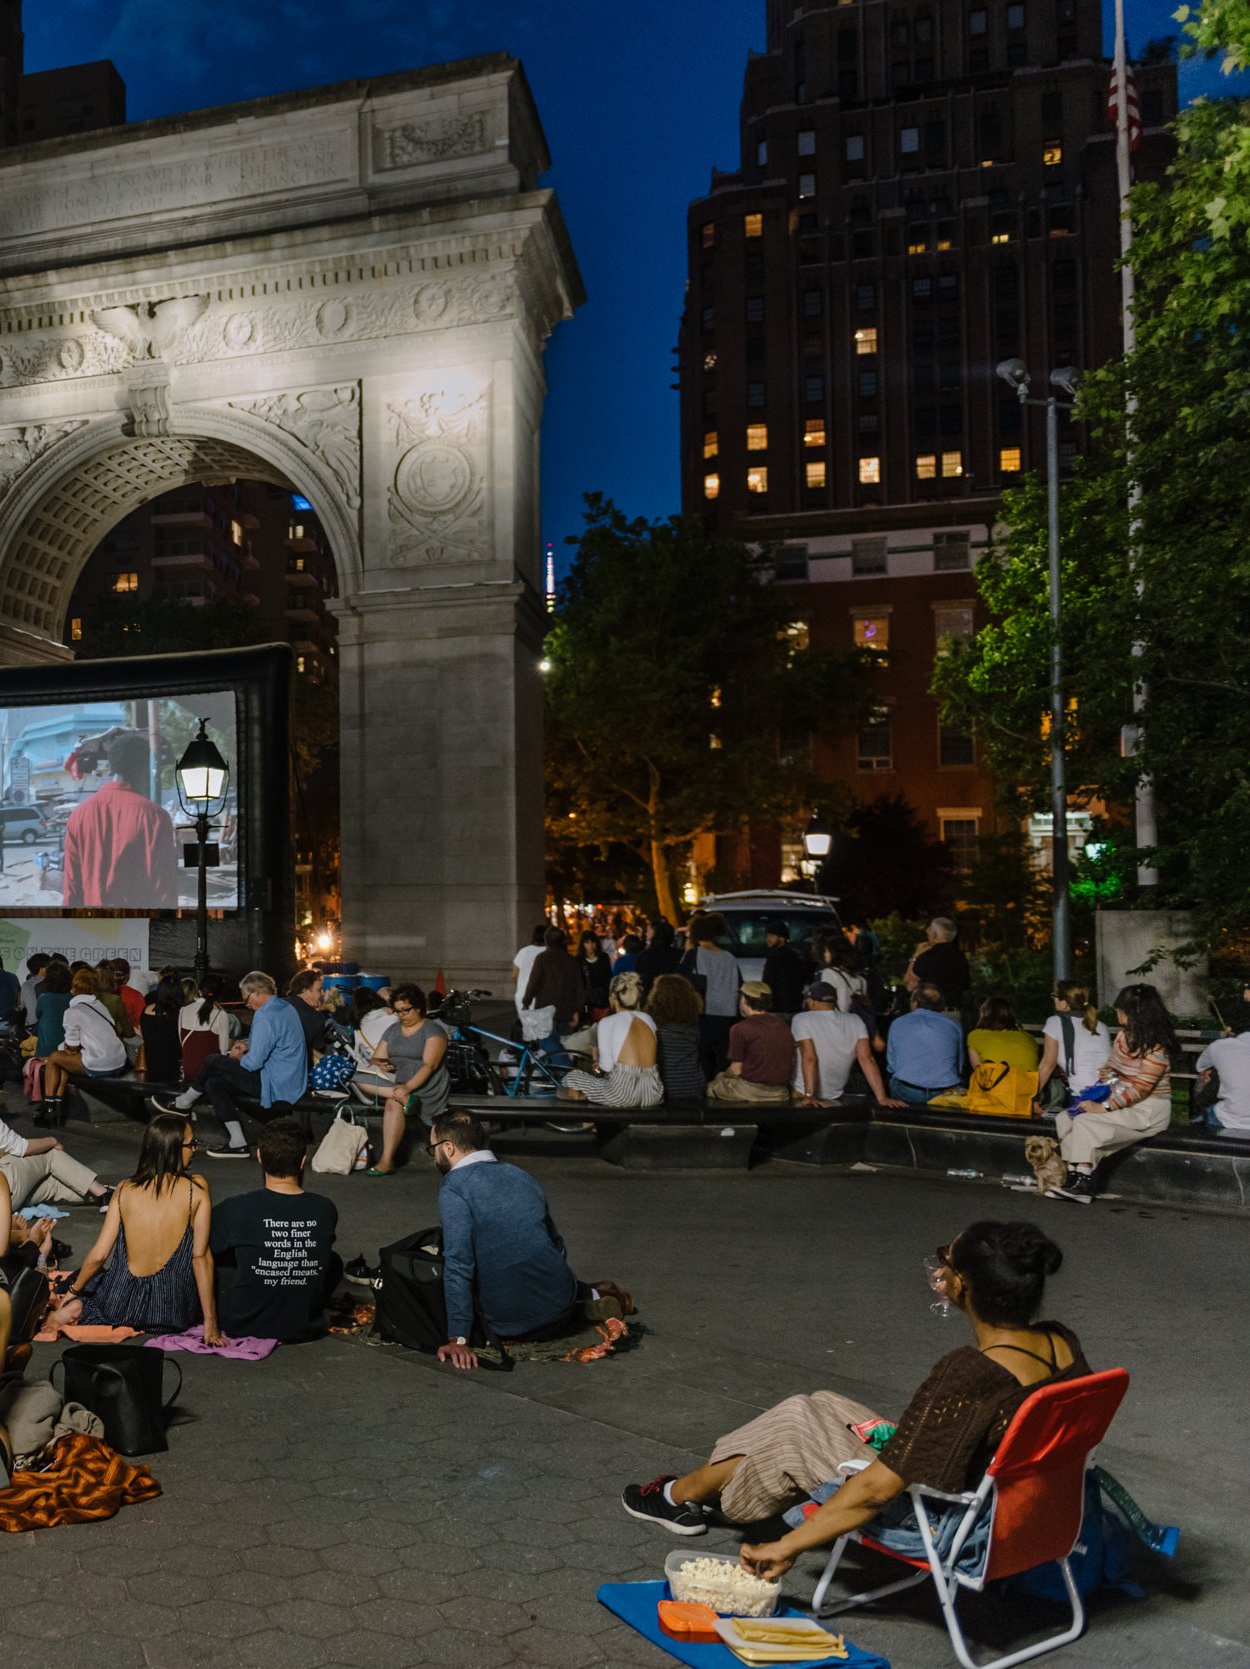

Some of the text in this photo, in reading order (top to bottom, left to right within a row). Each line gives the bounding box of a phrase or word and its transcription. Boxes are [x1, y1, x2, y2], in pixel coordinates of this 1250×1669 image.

[79, 947, 142, 961] GREEN
[263, 1219, 289, 1228] There
[271, 1229, 311, 1238] two finer
[264, 1238, 317, 1248] words in the
[274, 1249, 308, 1260] English
[258, 1257, 319, 1269] language than
[251, 1265, 291, 1277] "encased
[264, 1277, 308, 1287] my friend.
